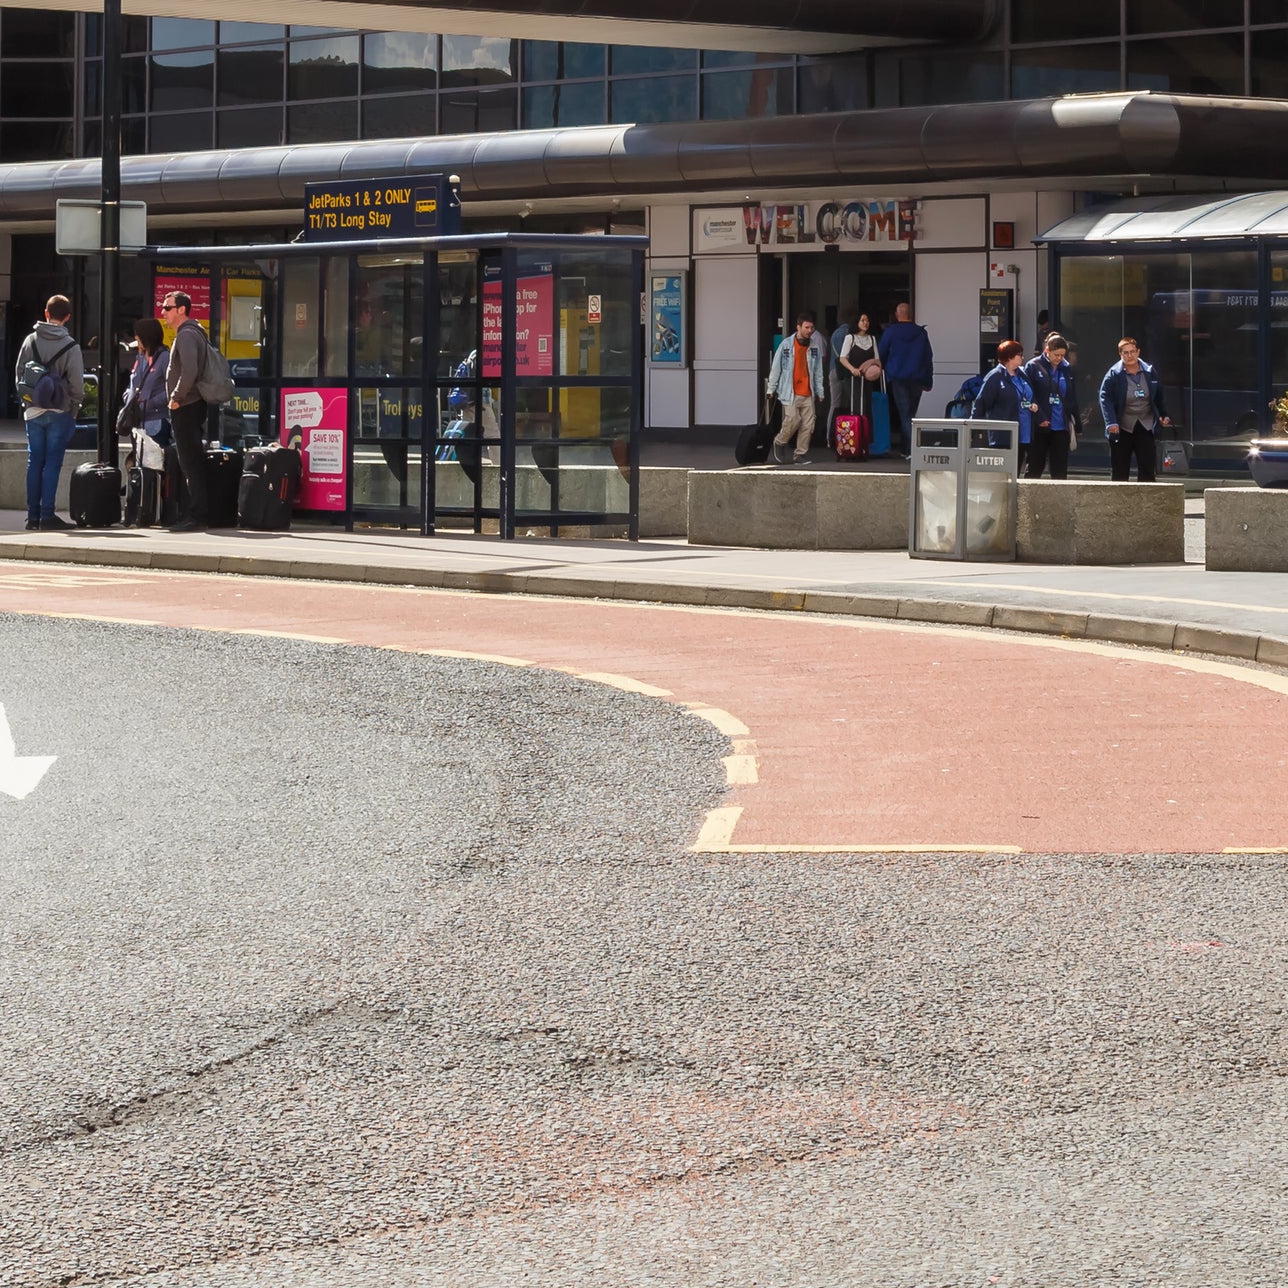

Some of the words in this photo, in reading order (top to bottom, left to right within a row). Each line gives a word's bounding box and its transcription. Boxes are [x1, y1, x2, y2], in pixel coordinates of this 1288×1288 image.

[309, 193, 351, 210] JetParks
[355, 192, 360, 207] 1
[363, 191, 371, 206] &
[375, 190, 382, 205] 2
[385, 188, 411, 205] ONLY
[309, 213, 337, 229] T1/T3
[340, 213, 365, 230] Long
[368, 211, 392, 228] Stay
[743, 200, 920, 245] WELCOME
[156, 265, 197, 275] Manchester
[523, 289, 537, 299] free
[526, 303, 537, 313] for
[313, 433, 327, 443] SAVE
[923, 455, 950, 465] LITTER
[976, 455, 1005, 466] LITTER
